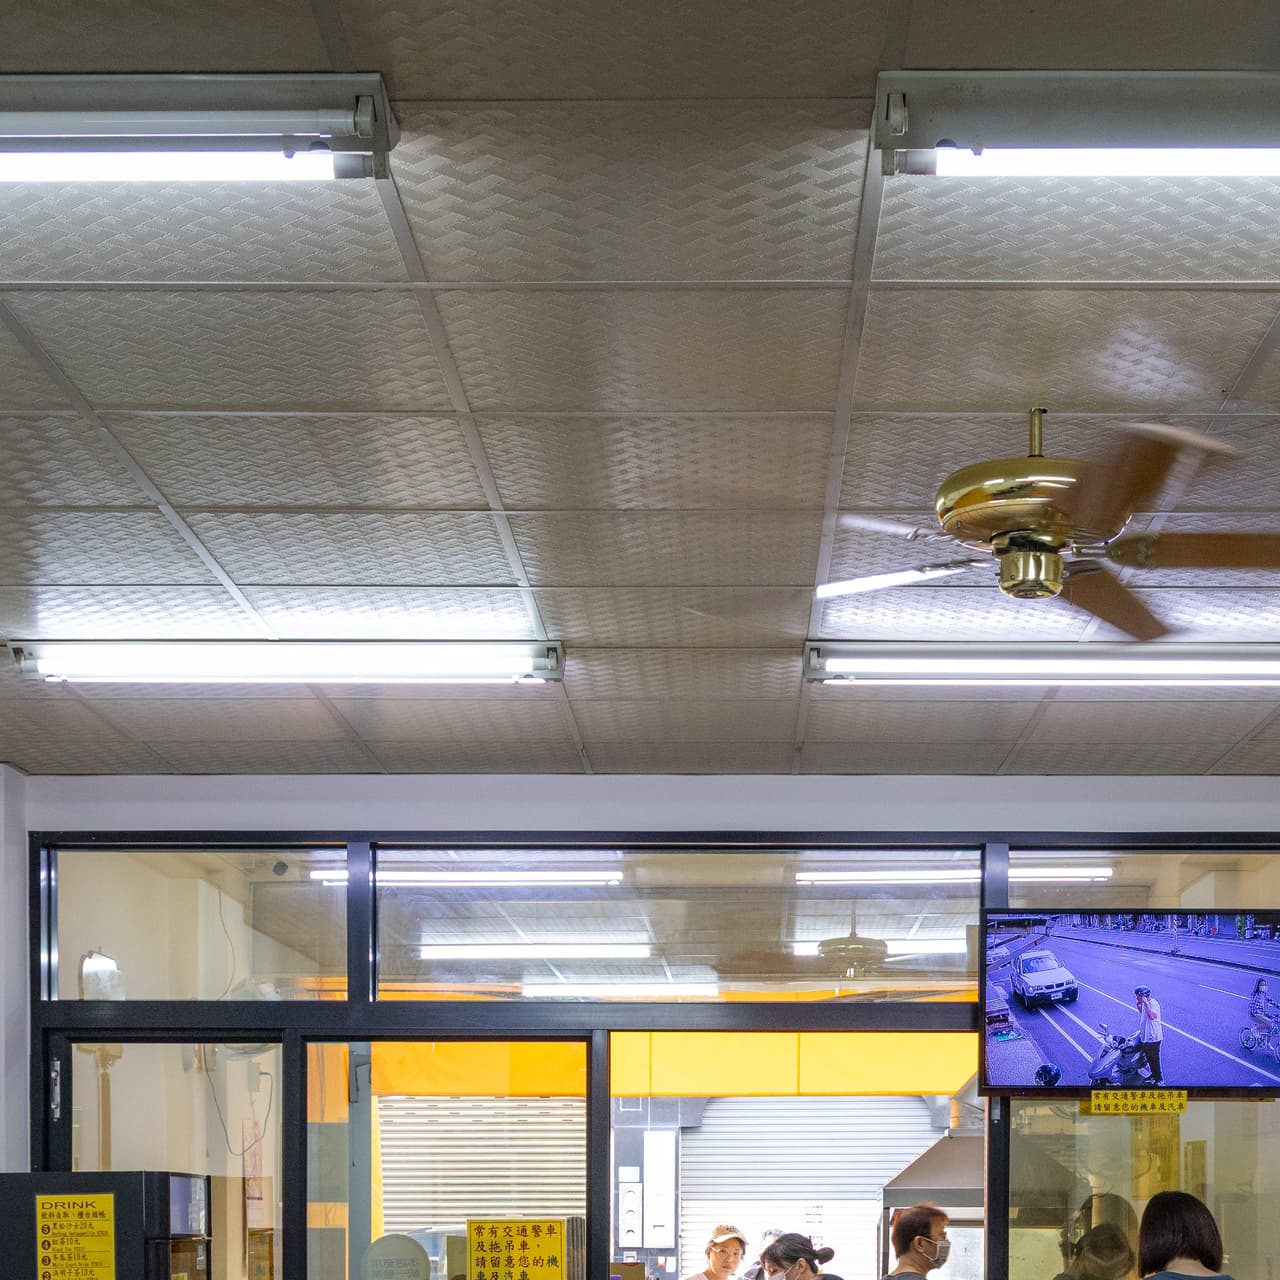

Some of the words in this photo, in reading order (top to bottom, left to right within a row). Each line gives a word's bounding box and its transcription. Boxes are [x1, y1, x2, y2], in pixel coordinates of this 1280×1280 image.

[1093, 1091, 1184, 1100] 常有交通警車及拖吊車
[1094, 1103, 1185, 1112] 請留意您的機車及汽車
[41, 1201, 97, 1210] DRINK
[474, 1224, 558, 1239] 常有交通警車
[474, 1255, 560, 1269] 請留意您的機
